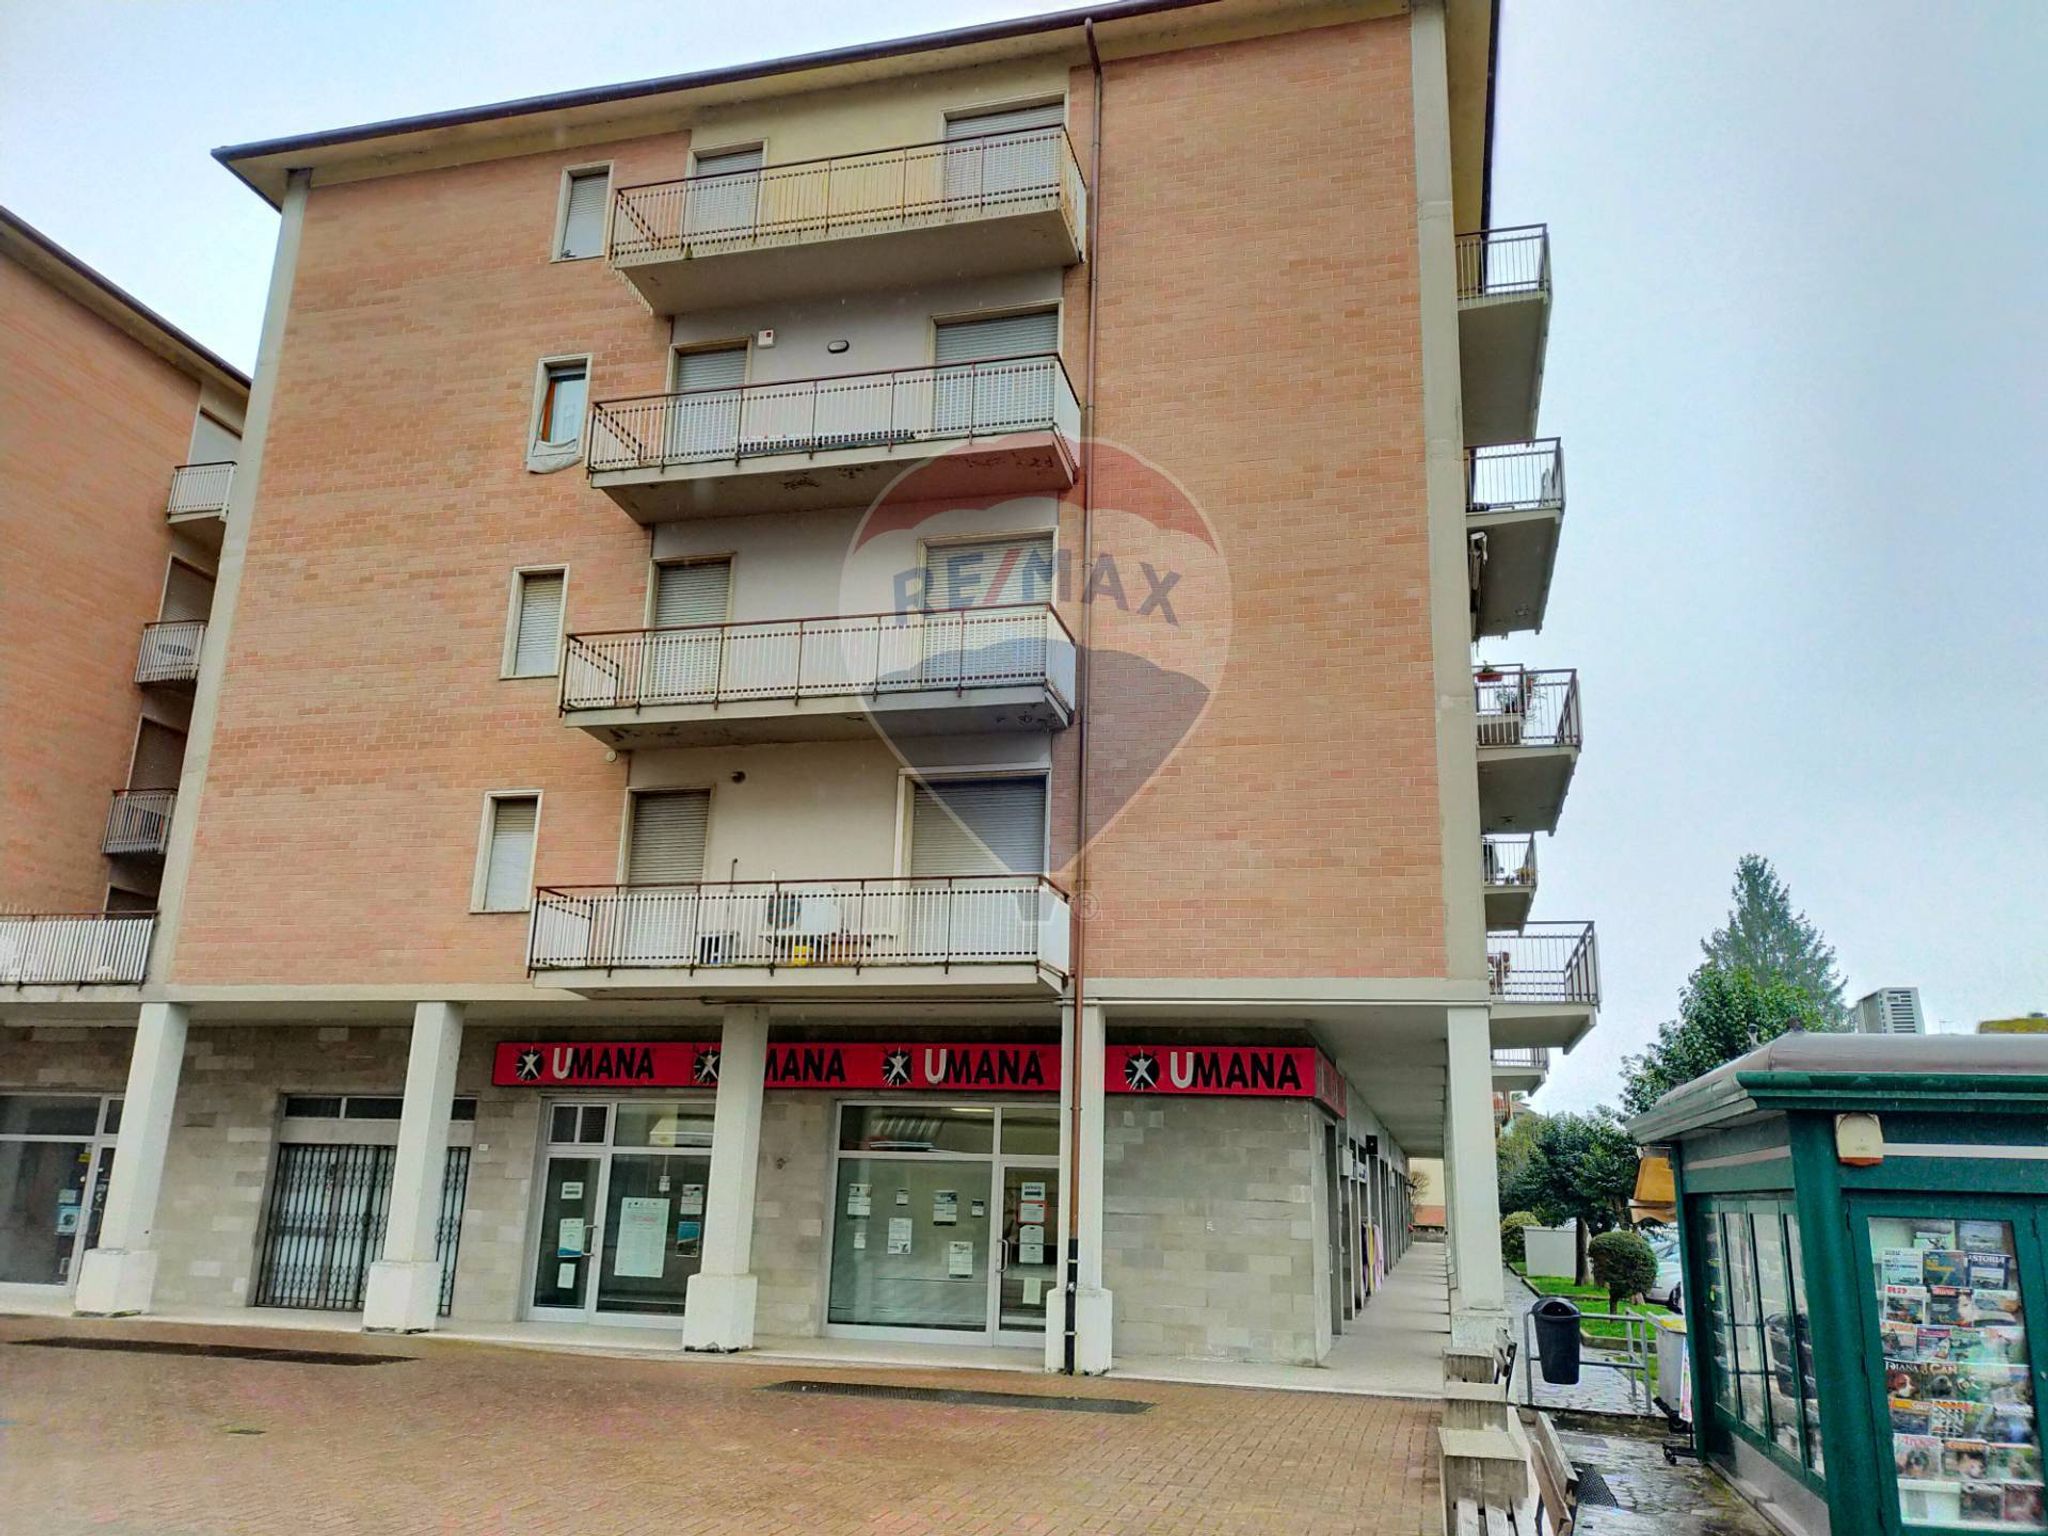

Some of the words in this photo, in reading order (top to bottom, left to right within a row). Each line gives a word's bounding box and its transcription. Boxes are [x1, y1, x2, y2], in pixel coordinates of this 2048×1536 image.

[552, 1047, 655, 1080] UMANA
[765, 1047, 847, 1083] MANA
[924, 1048, 1046, 1085] UMANA
[1169, 1051, 1303, 1091] UMANA
